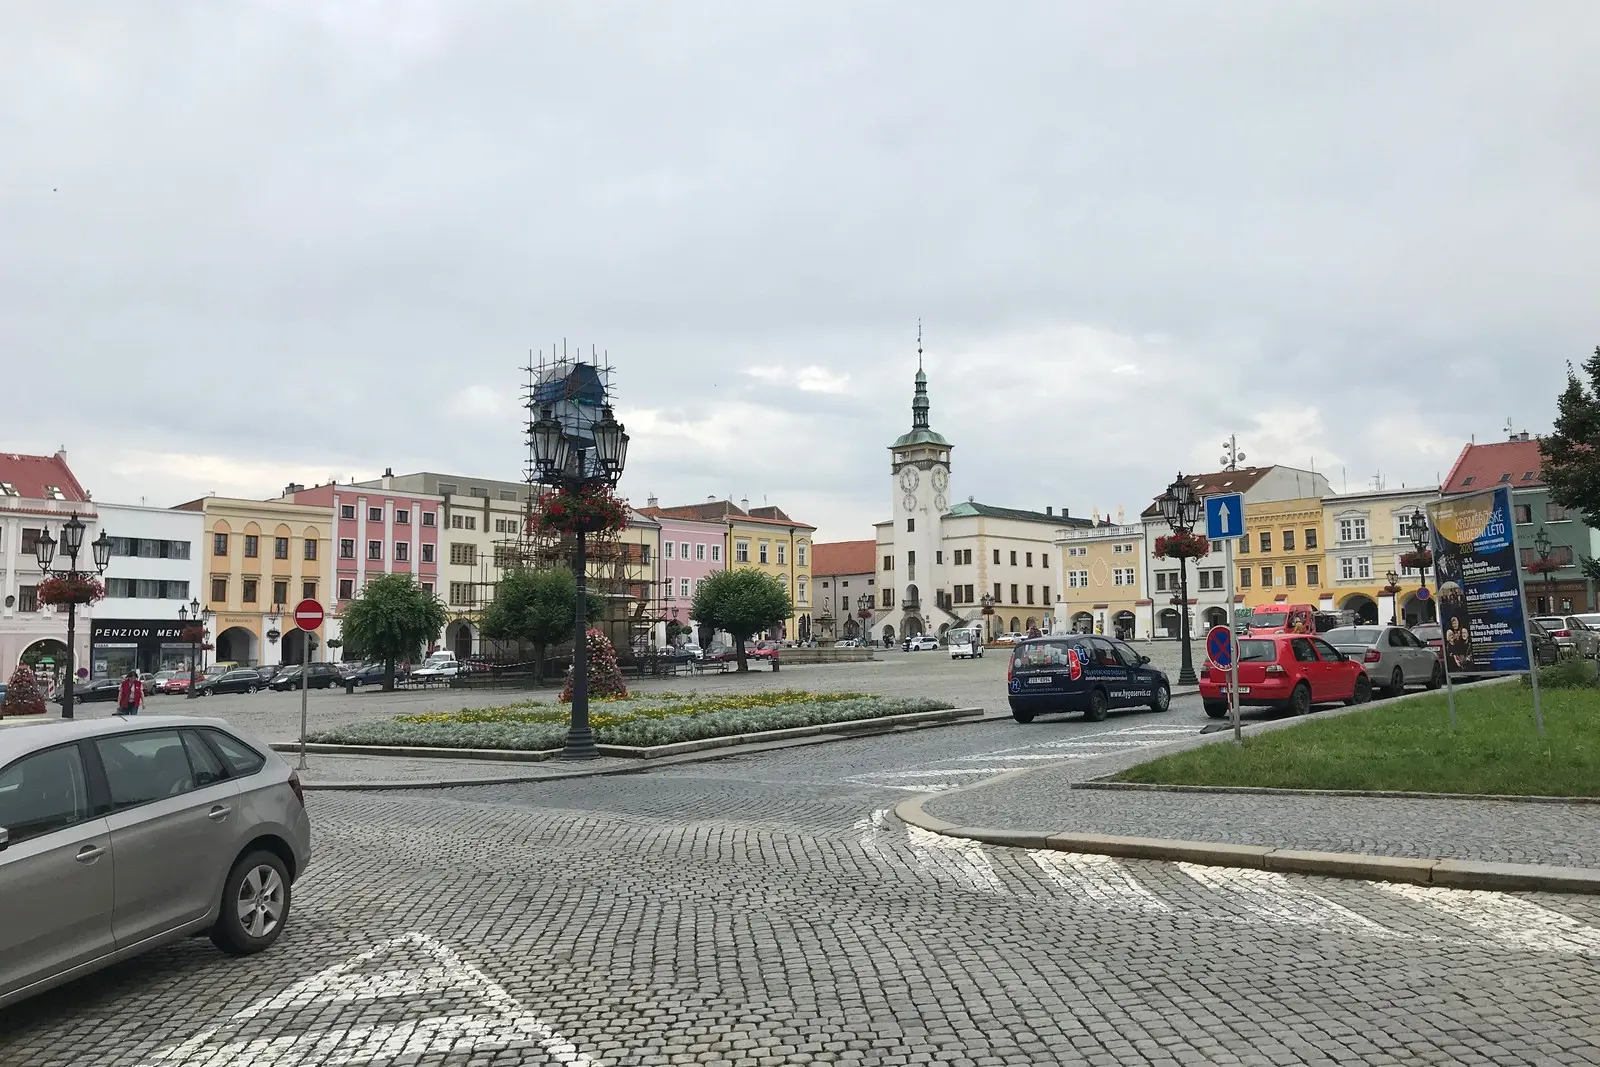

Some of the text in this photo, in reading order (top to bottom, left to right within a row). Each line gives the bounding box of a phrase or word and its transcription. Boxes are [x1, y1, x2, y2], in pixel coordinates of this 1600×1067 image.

[1487, 523, 1505, 537] LÉTO
[1459, 543, 1473, 554] 2020
[95, 628, 149, 637] PENZION
